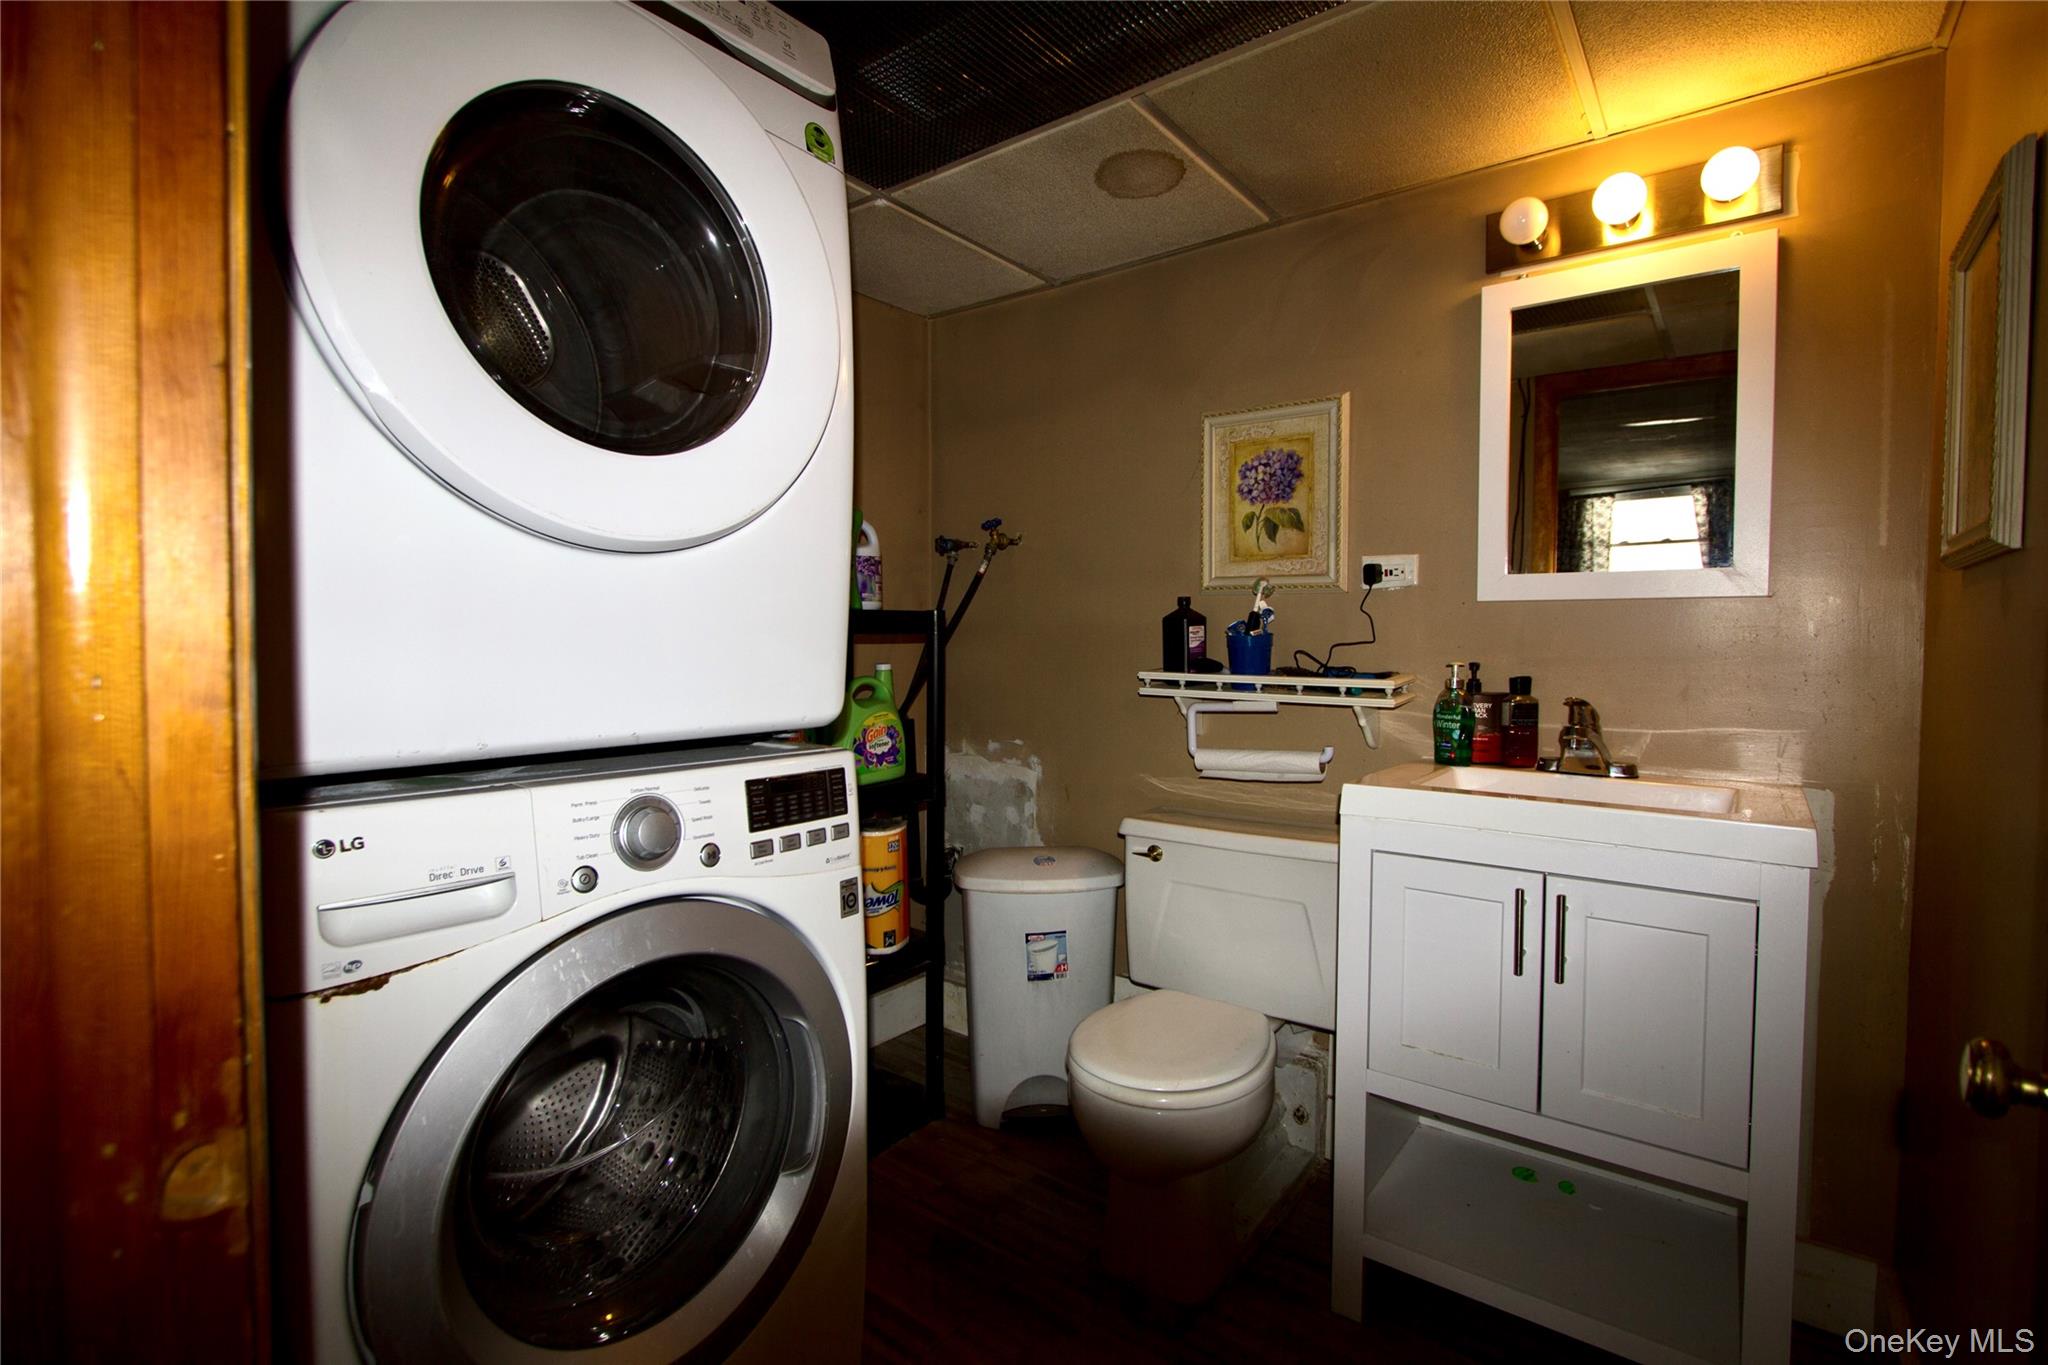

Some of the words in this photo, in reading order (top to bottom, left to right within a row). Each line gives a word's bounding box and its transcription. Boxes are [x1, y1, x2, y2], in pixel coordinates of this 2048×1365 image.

[867, 725, 886, 742] Gain
[339, 837, 365, 852] LG
[460, 865, 484, 876] Drive
[864, 888, 899, 908] Towe
